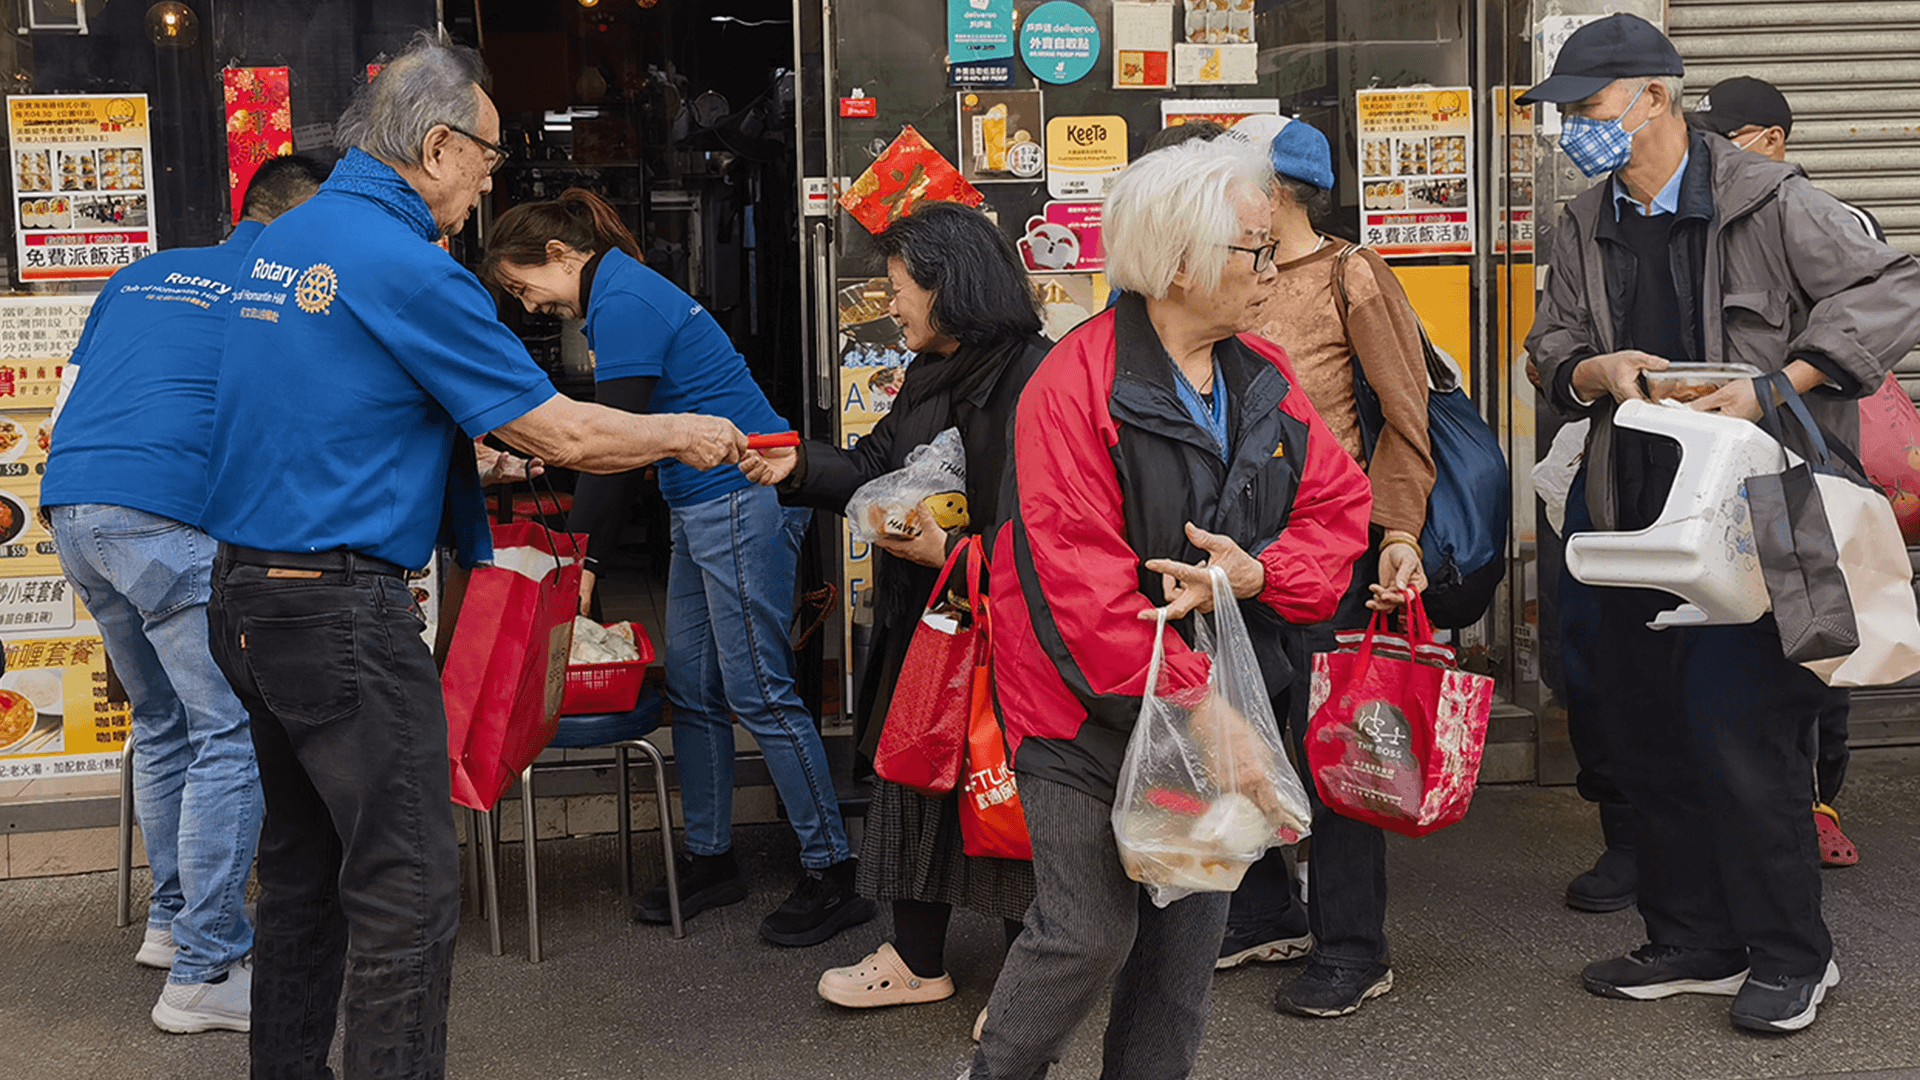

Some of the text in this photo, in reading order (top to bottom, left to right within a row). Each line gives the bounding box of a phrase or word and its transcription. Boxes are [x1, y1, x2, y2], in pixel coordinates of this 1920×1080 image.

[1367, 224, 1469, 245] 免費派飯活動
[26, 245, 150, 268] 免費派飯活動
[164, 272, 232, 295] Rotary
[251, 258, 299, 288] Rotary
[844, 383, 867, 412] A
[887, 519, 916, 536] HAVE
[1357, 741, 1402, 759] THE BOSS
